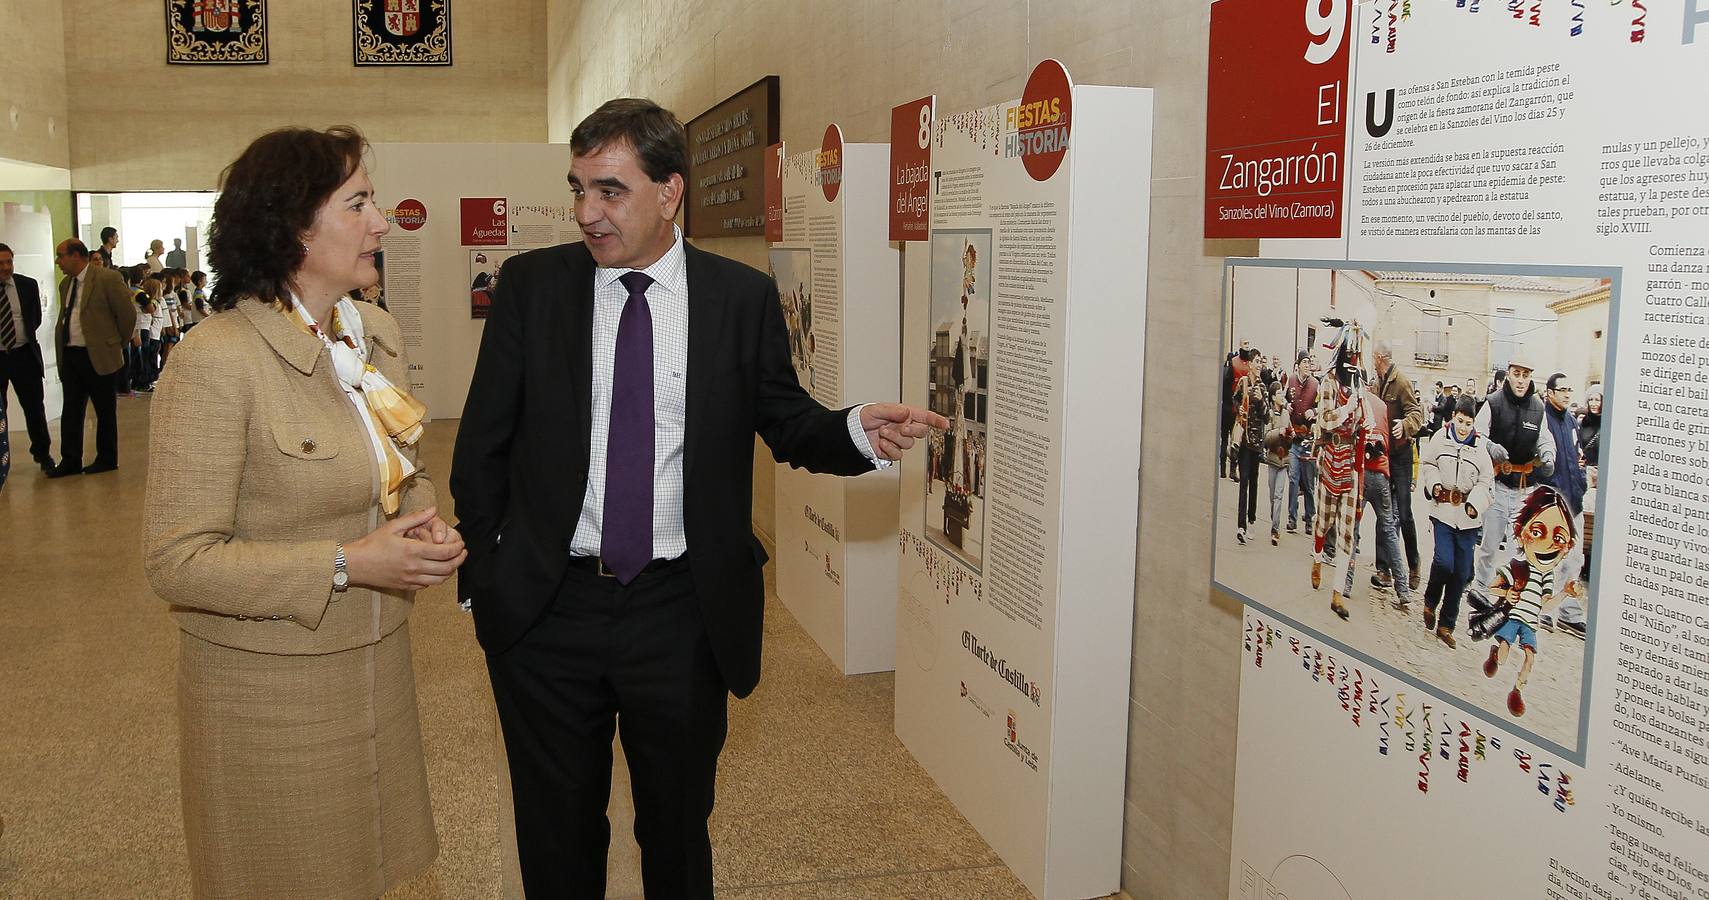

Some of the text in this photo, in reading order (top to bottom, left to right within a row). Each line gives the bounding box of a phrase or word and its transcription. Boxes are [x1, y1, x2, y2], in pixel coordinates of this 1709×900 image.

[1303, 0, 1346, 64] 9
[1397, 73, 1570, 109] como telón de fondo: así explica la tradición el
[1398, 88, 1406, 97] na
[1408, 84, 1429, 95] ofensa
[1436, 80, 1449, 90] San
[1451, 75, 1480, 88] Esteban
[1481, 73, 1495, 83] con
[1497, 70, 1504, 81] la
[1506, 65, 1535, 79] temida
[1536, 63, 1560, 77] peste
[1006, 97, 1060, 130] FIESTAS
[1318, 80, 1340, 126] El
[1365, 88, 1395, 138] U
[1397, 91, 1574, 124] origen de la fiesta zamorana del Zangarrón, que
[918, 104, 931, 150] 8
[1396, 127, 1403, 137] se
[1404, 122, 1428, 134] celebra
[1429, 123, 1438, 131] en
[1440, 120, 1446, 130] la
[1447, 116, 1479, 129] Sanzoles
[1480, 114, 1492, 125] del
[1494, 112, 1513, 123] Vino
[1514, 111, 1526, 121] los
[1528, 108, 1545, 120] días
[1546, 106, 1557, 118] 25
[1005, 127, 1069, 158] HISTORIA
[1364, 138, 1415, 152] 26 de diciembre.
[1602, 141, 1632, 154] mulas
[1643, 141, 1657, 152] un
[1660, 135, 1700, 152] pellejo,
[777, 147, 783, 178] 7
[896, 165, 905, 185] La
[906, 160, 928, 188] bajada
[1219, 142, 1337, 197] Zangarrón
[1601, 154, 1681, 172] rros que llevaba
[1600, 173, 1686, 189] que los agresores
[896, 191, 907, 214] del
[907, 188, 928, 218] Ángel
[1598, 192, 1637, 202] estatua,
[1649, 188, 1657, 200] la
[1660, 189, 1689, 202] peste
[385, 216, 427, 224] HISTORIA
[493, 200, 506, 216] 6
[1219, 200, 1335, 221] Sanzoles del Vino (Zamora)
[1598, 205, 1690, 220] tales prueban, por
[472, 228, 506, 238] Águedas
[492, 219, 506, 227] Las
[511, 225, 518, 233] L
[1596, 218, 1651, 236] siglo XVIII.
[1650, 244, 1705, 256] Comienza
[1648, 261, 1703, 273] una danza
[1646, 278, 1681, 291] garrón
[1646, 294, 1682, 306] Cuatro
[1644, 312, 1704, 324] racterística
[1653, 333, 1667, 345] las
[1670, 334, 1696, 348] siete
[1640, 366, 1708, 383] se dirigen de
[1639, 380, 1685, 397] iniciar el
[1653, 402, 1672, 412] con
[1632, 463, 1660, 478] palda
[1671, 471, 1703, 484] modo
[1640, 481, 1661, 493] otra
[1664, 483, 1699, 501] blanca
[1630, 495, 1682, 514] anudan al
[1627, 542, 1692, 567] para guardar
[1625, 555, 1692, 584] lleva un palo
[1623, 593, 1692, 624] En las Cuatro
[1620, 626, 1660, 646] morano
[1672, 642, 1682, 655] el
[998, 658, 1029, 697] Castilla
[1617, 657, 1663, 680] separado
[1674, 675, 1691, 691] dar
[1693, 681, 1708, 697] las
[1624, 690, 1654, 711] poner
[1656, 700, 1665, 715] la
[1668, 705, 1696, 726] bolsa
[1613, 717, 1662, 745] conforme
[1672, 740, 1682, 755] la
[1642, 751, 1673, 773] María
[1615, 762, 1664, 791] Adelante.
[1612, 802, 1664, 837] Yo mismo.
[1629, 791, 1658, 812] quién
[1660, 806, 1693, 828] recibe
[1610, 823, 1708, 882] Tenga usted felices
[1610, 839, 1625, 856] del
[1628, 848, 1649, 870] Hijo
[1652, 861, 1664, 876] de
